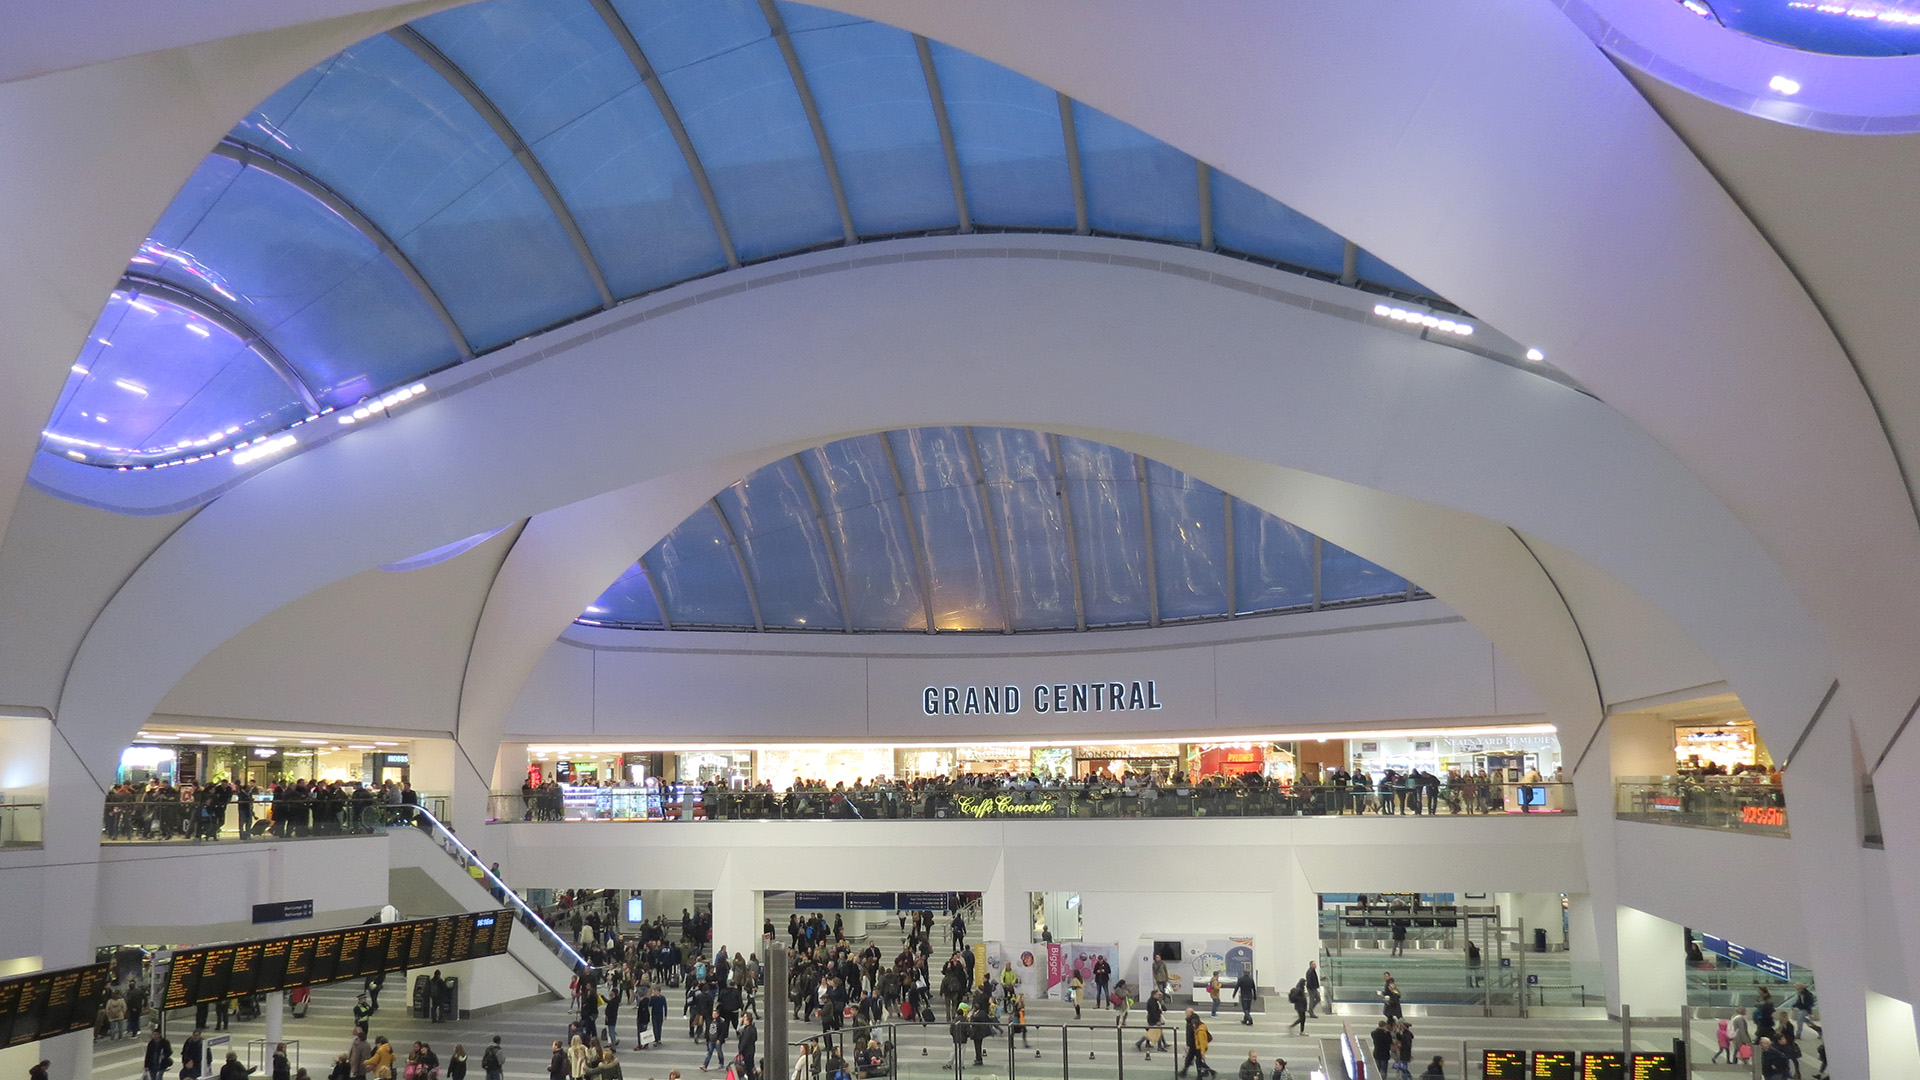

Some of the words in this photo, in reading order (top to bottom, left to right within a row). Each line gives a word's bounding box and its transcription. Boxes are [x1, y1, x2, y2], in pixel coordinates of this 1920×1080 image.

[923, 685, 1020, 715] GRAND
[1034, 681, 1161, 713] CENTRAL
[1506, 737, 1556, 745] REMEDIES
[1078, 750, 1131, 758] MONSOON
[1227, 753, 1254, 762] PYLONES
[995, 795, 1052, 814] Concerto
[1049, 947, 1059, 976] Bigger
